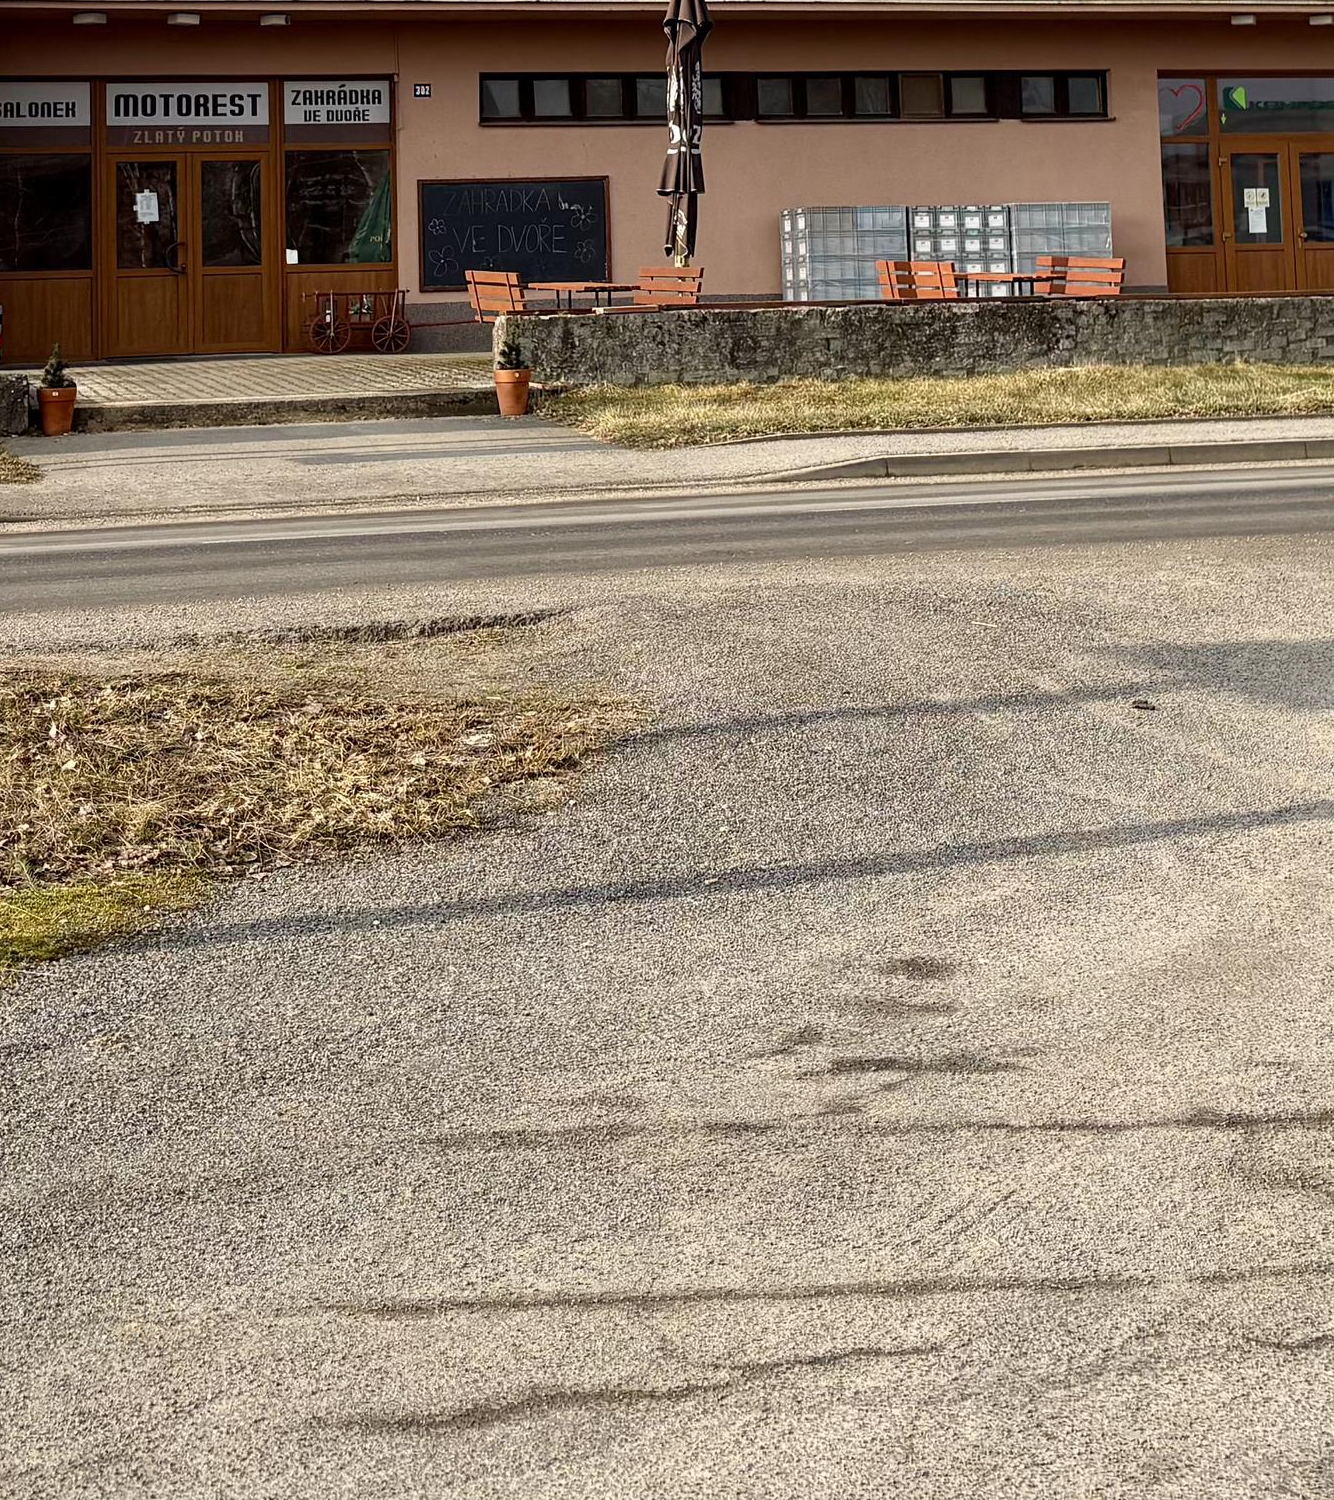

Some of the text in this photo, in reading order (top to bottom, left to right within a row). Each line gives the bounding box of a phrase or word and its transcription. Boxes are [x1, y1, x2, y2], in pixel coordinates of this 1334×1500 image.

[290, 84, 382, 106] ZAHRÁDKA
[415, 85, 430, 96] 302
[114, 93, 262, 118] MOTOREST
[303, 106, 370, 123] VE DVOŘE
[133, 127, 244, 144] ZLATÝ POTOK
[452, 217, 568, 253] VE DVOŘE
